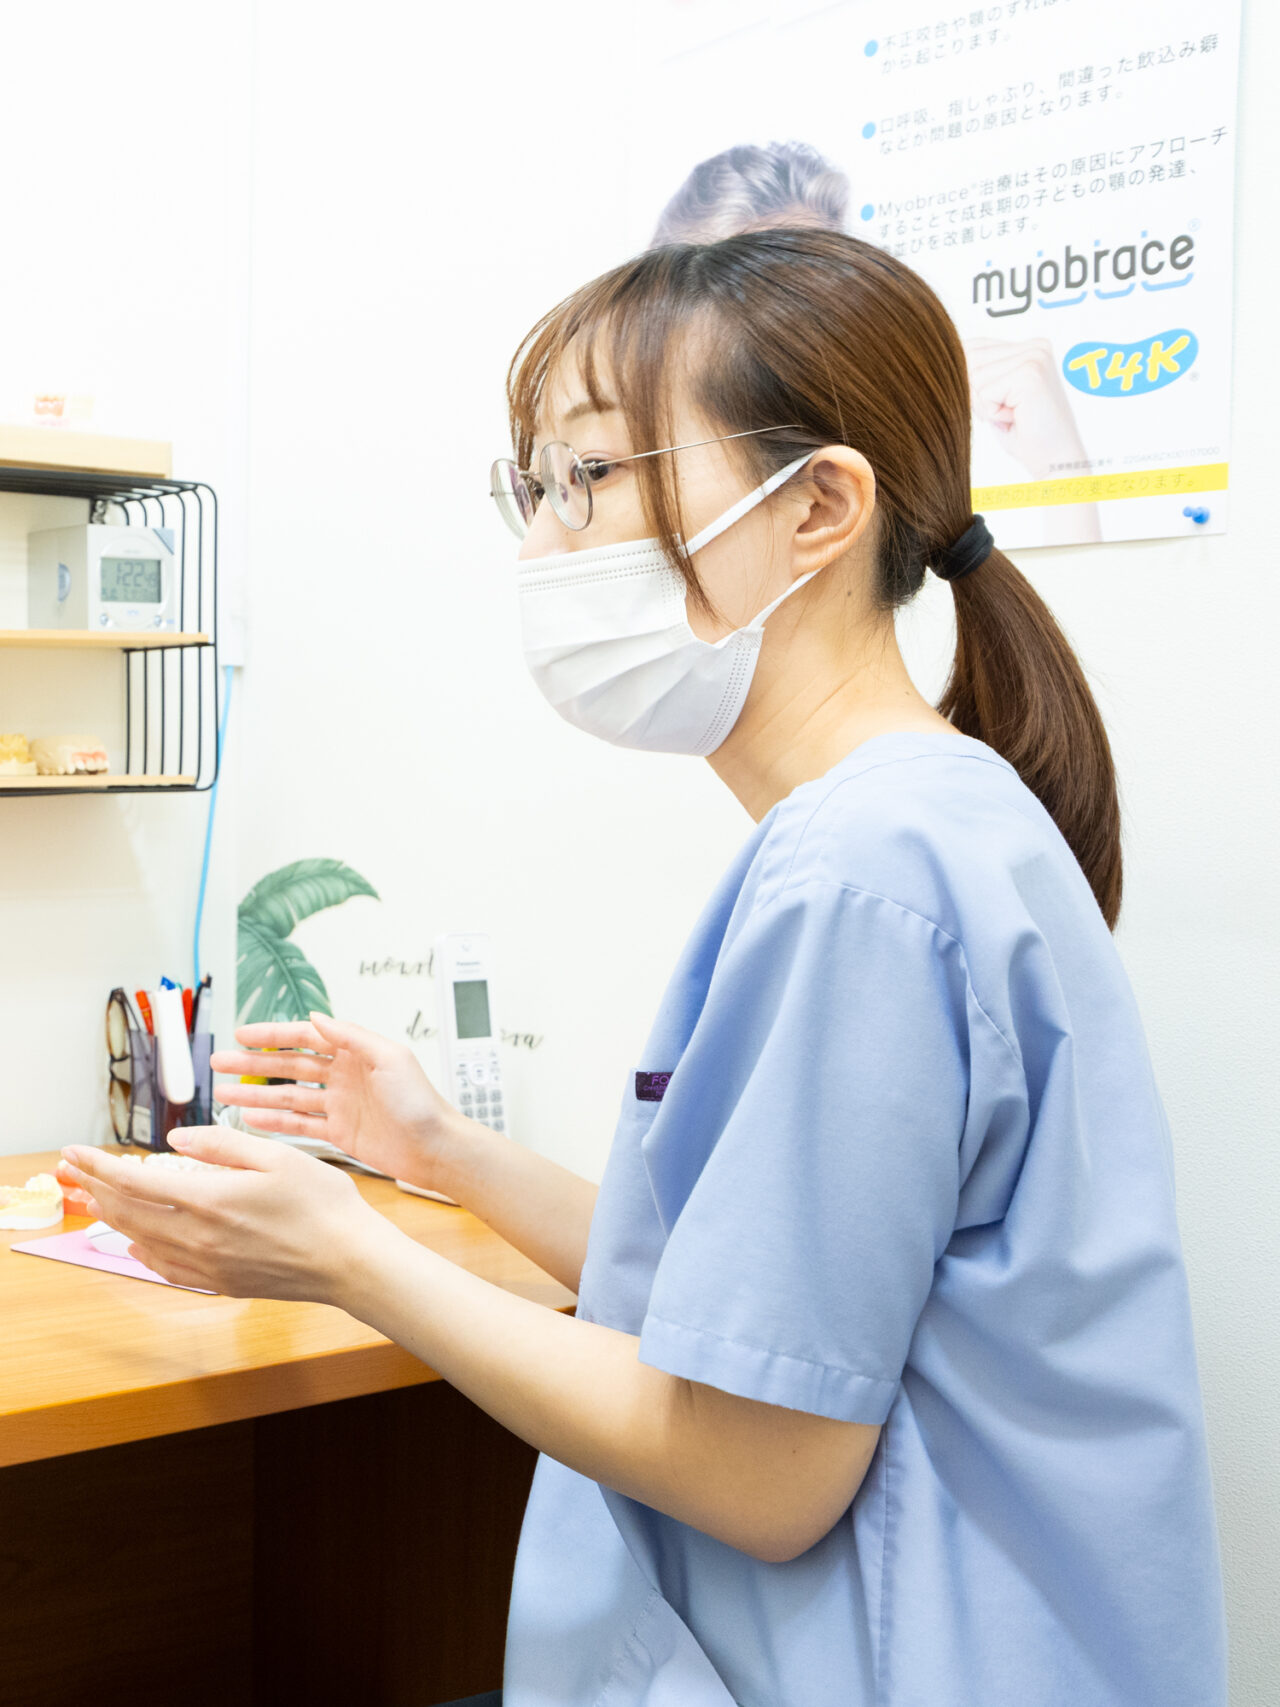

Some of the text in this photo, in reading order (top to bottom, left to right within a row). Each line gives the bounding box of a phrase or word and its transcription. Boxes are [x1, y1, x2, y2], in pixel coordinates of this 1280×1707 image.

[882, 28, 1011, 74] から起こります。
[972, 234, 1195, 317] myobrace
[1068, 334, 1191, 391] T4K
